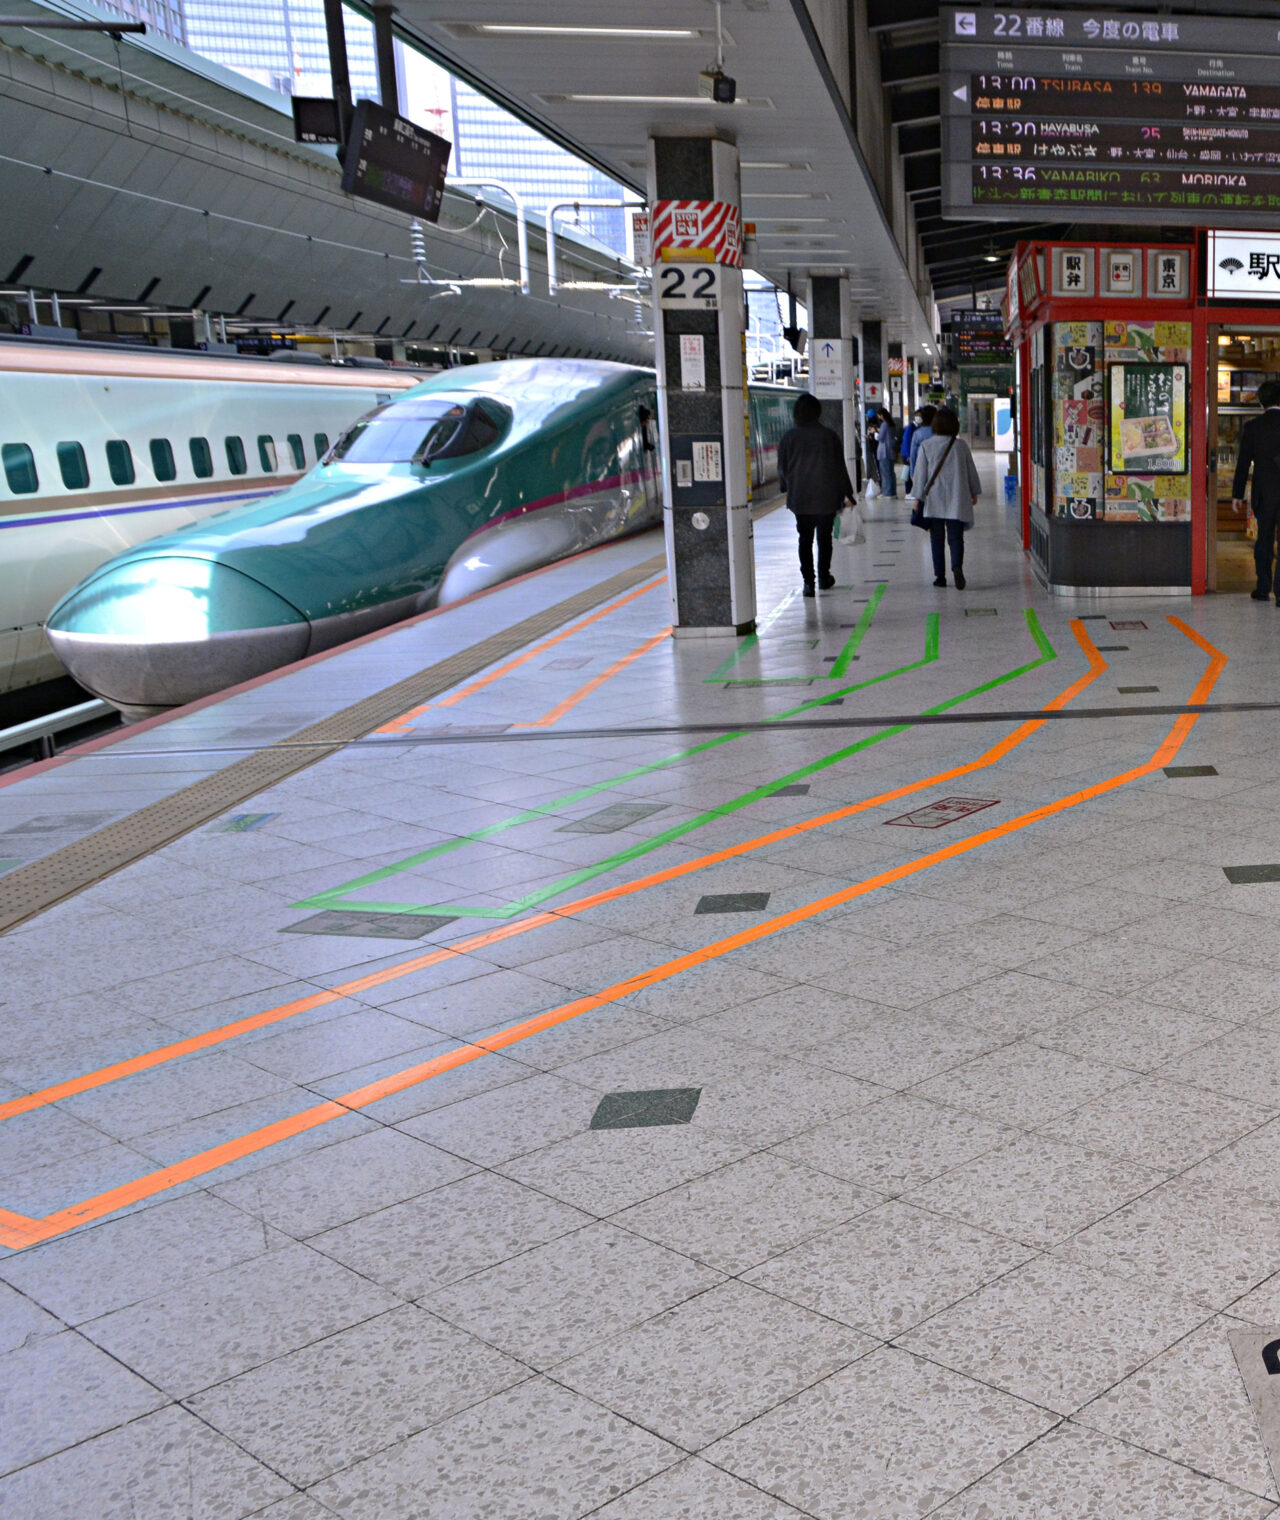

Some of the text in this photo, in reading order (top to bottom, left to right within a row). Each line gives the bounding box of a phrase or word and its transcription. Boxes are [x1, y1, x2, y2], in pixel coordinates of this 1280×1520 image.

[993, 14, 1180, 42] 22番線 今度の電車
[1197, 68, 1235, 77] Destination
[1040, 122, 1100, 135] HAYABUSA
[661, 267, 717, 299] 22
[1066, 255, 1081, 287] 駅弁
[1162, 257, 1176, 289] 東京
